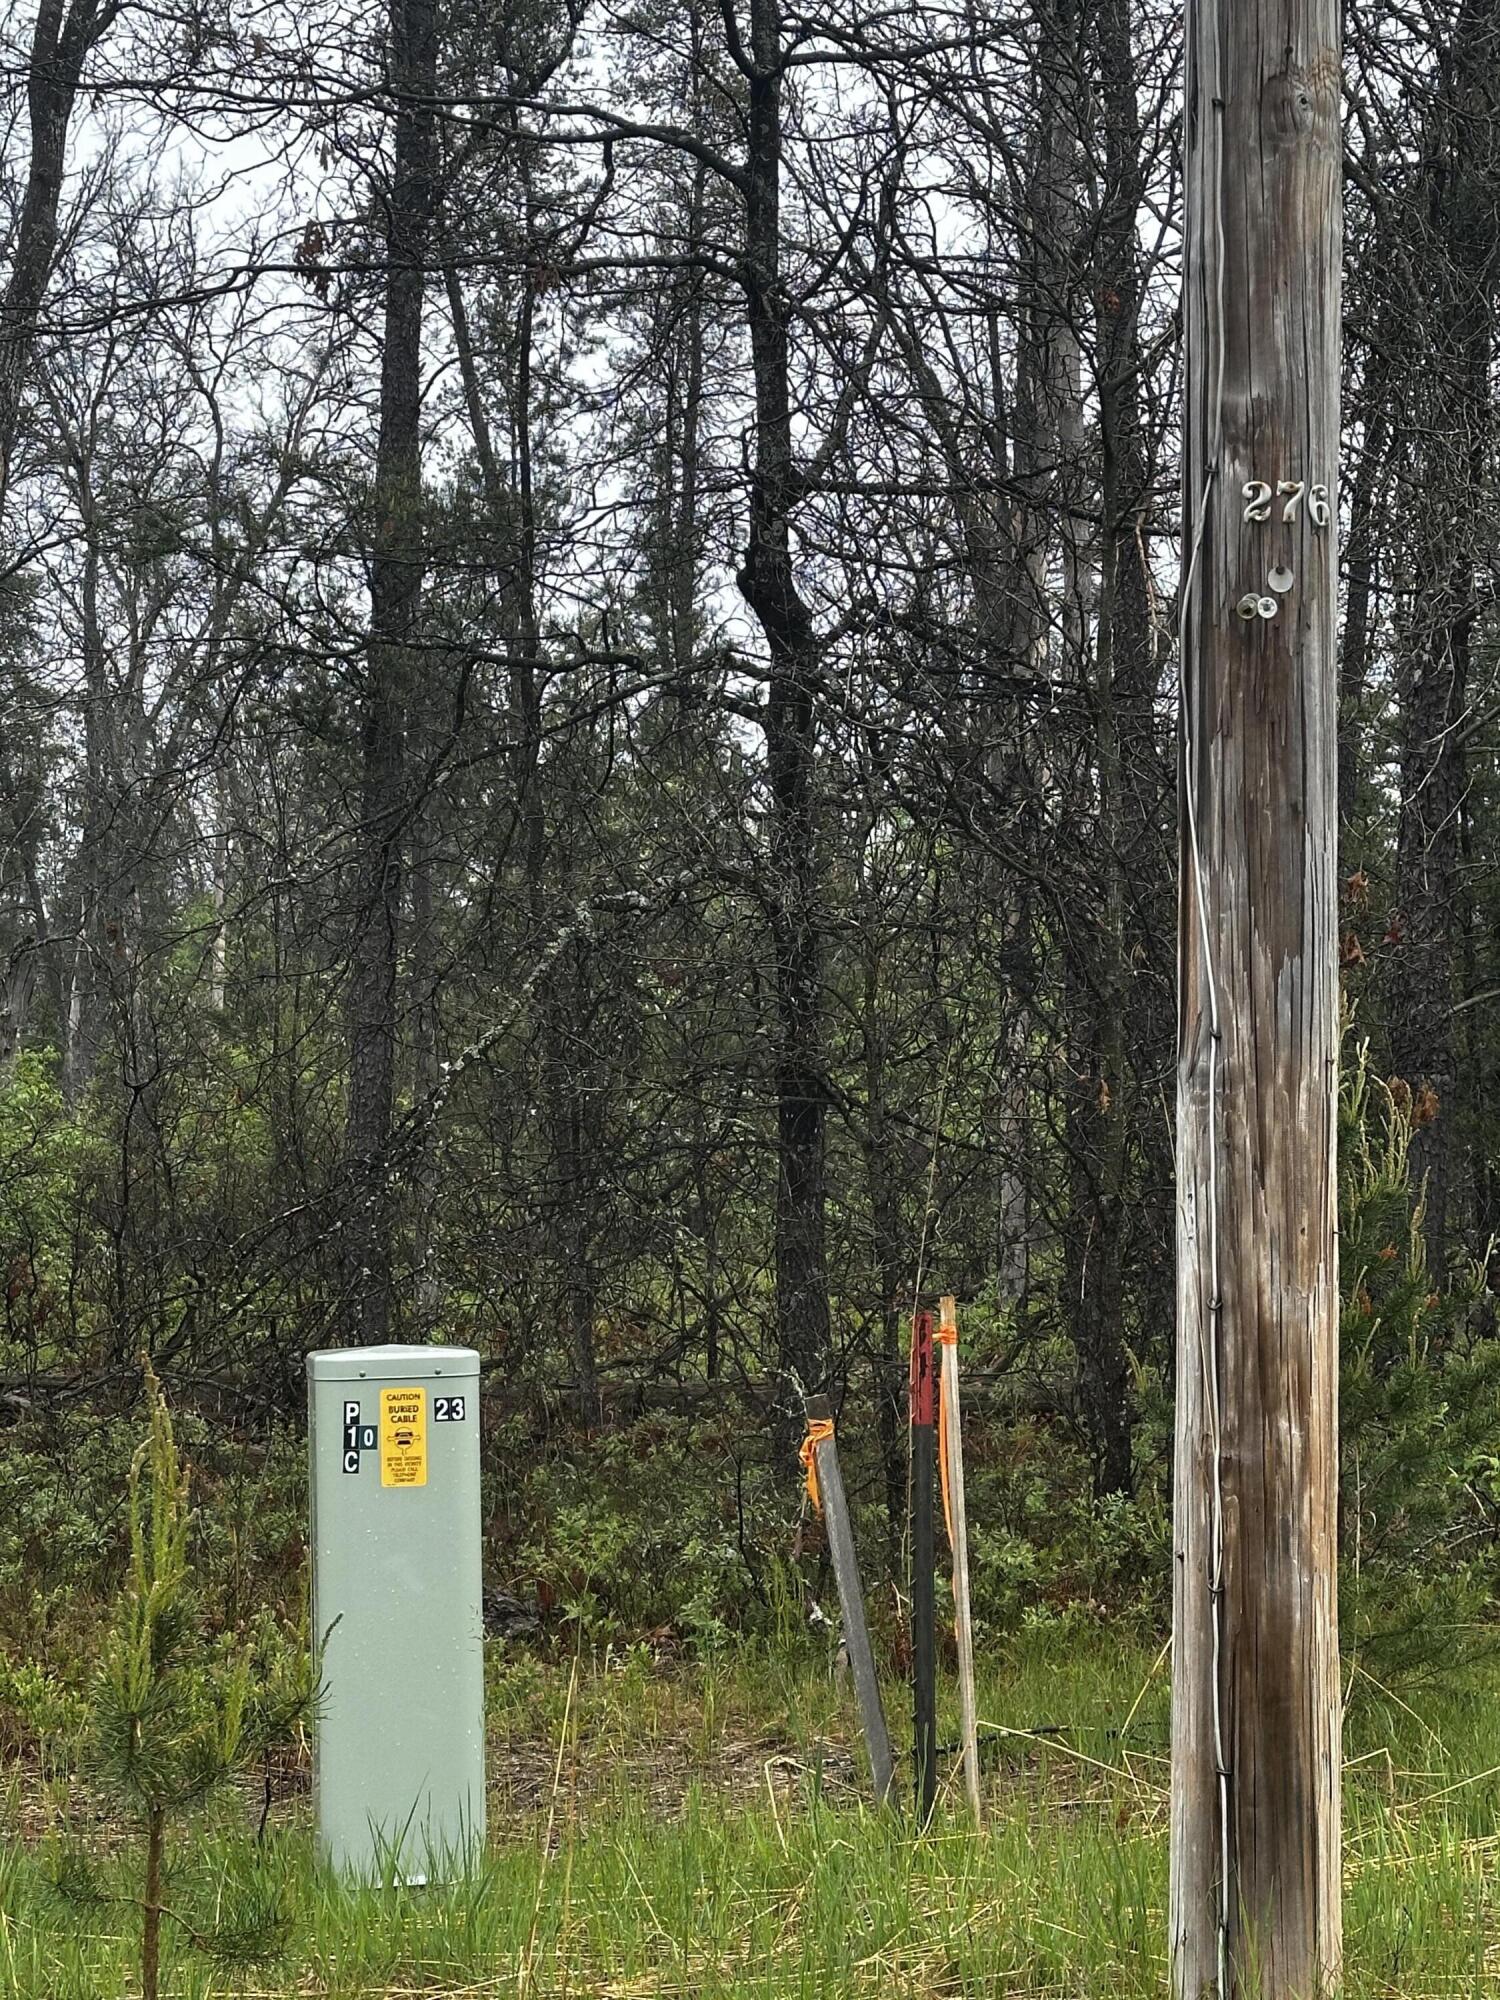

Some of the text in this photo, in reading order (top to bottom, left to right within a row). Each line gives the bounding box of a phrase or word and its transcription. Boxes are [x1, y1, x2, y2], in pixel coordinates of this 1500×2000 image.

[1242, 480, 1330, 526] 276
[386, 1393, 420, 1401] CAUTION
[346, 1403, 359, 1424] P
[388, 1405, 419, 1414] BURIED
[390, 1415, 417, 1423] CABLE
[436, 1399, 465, 1420] 23
[344, 1451, 358, 1472] C
